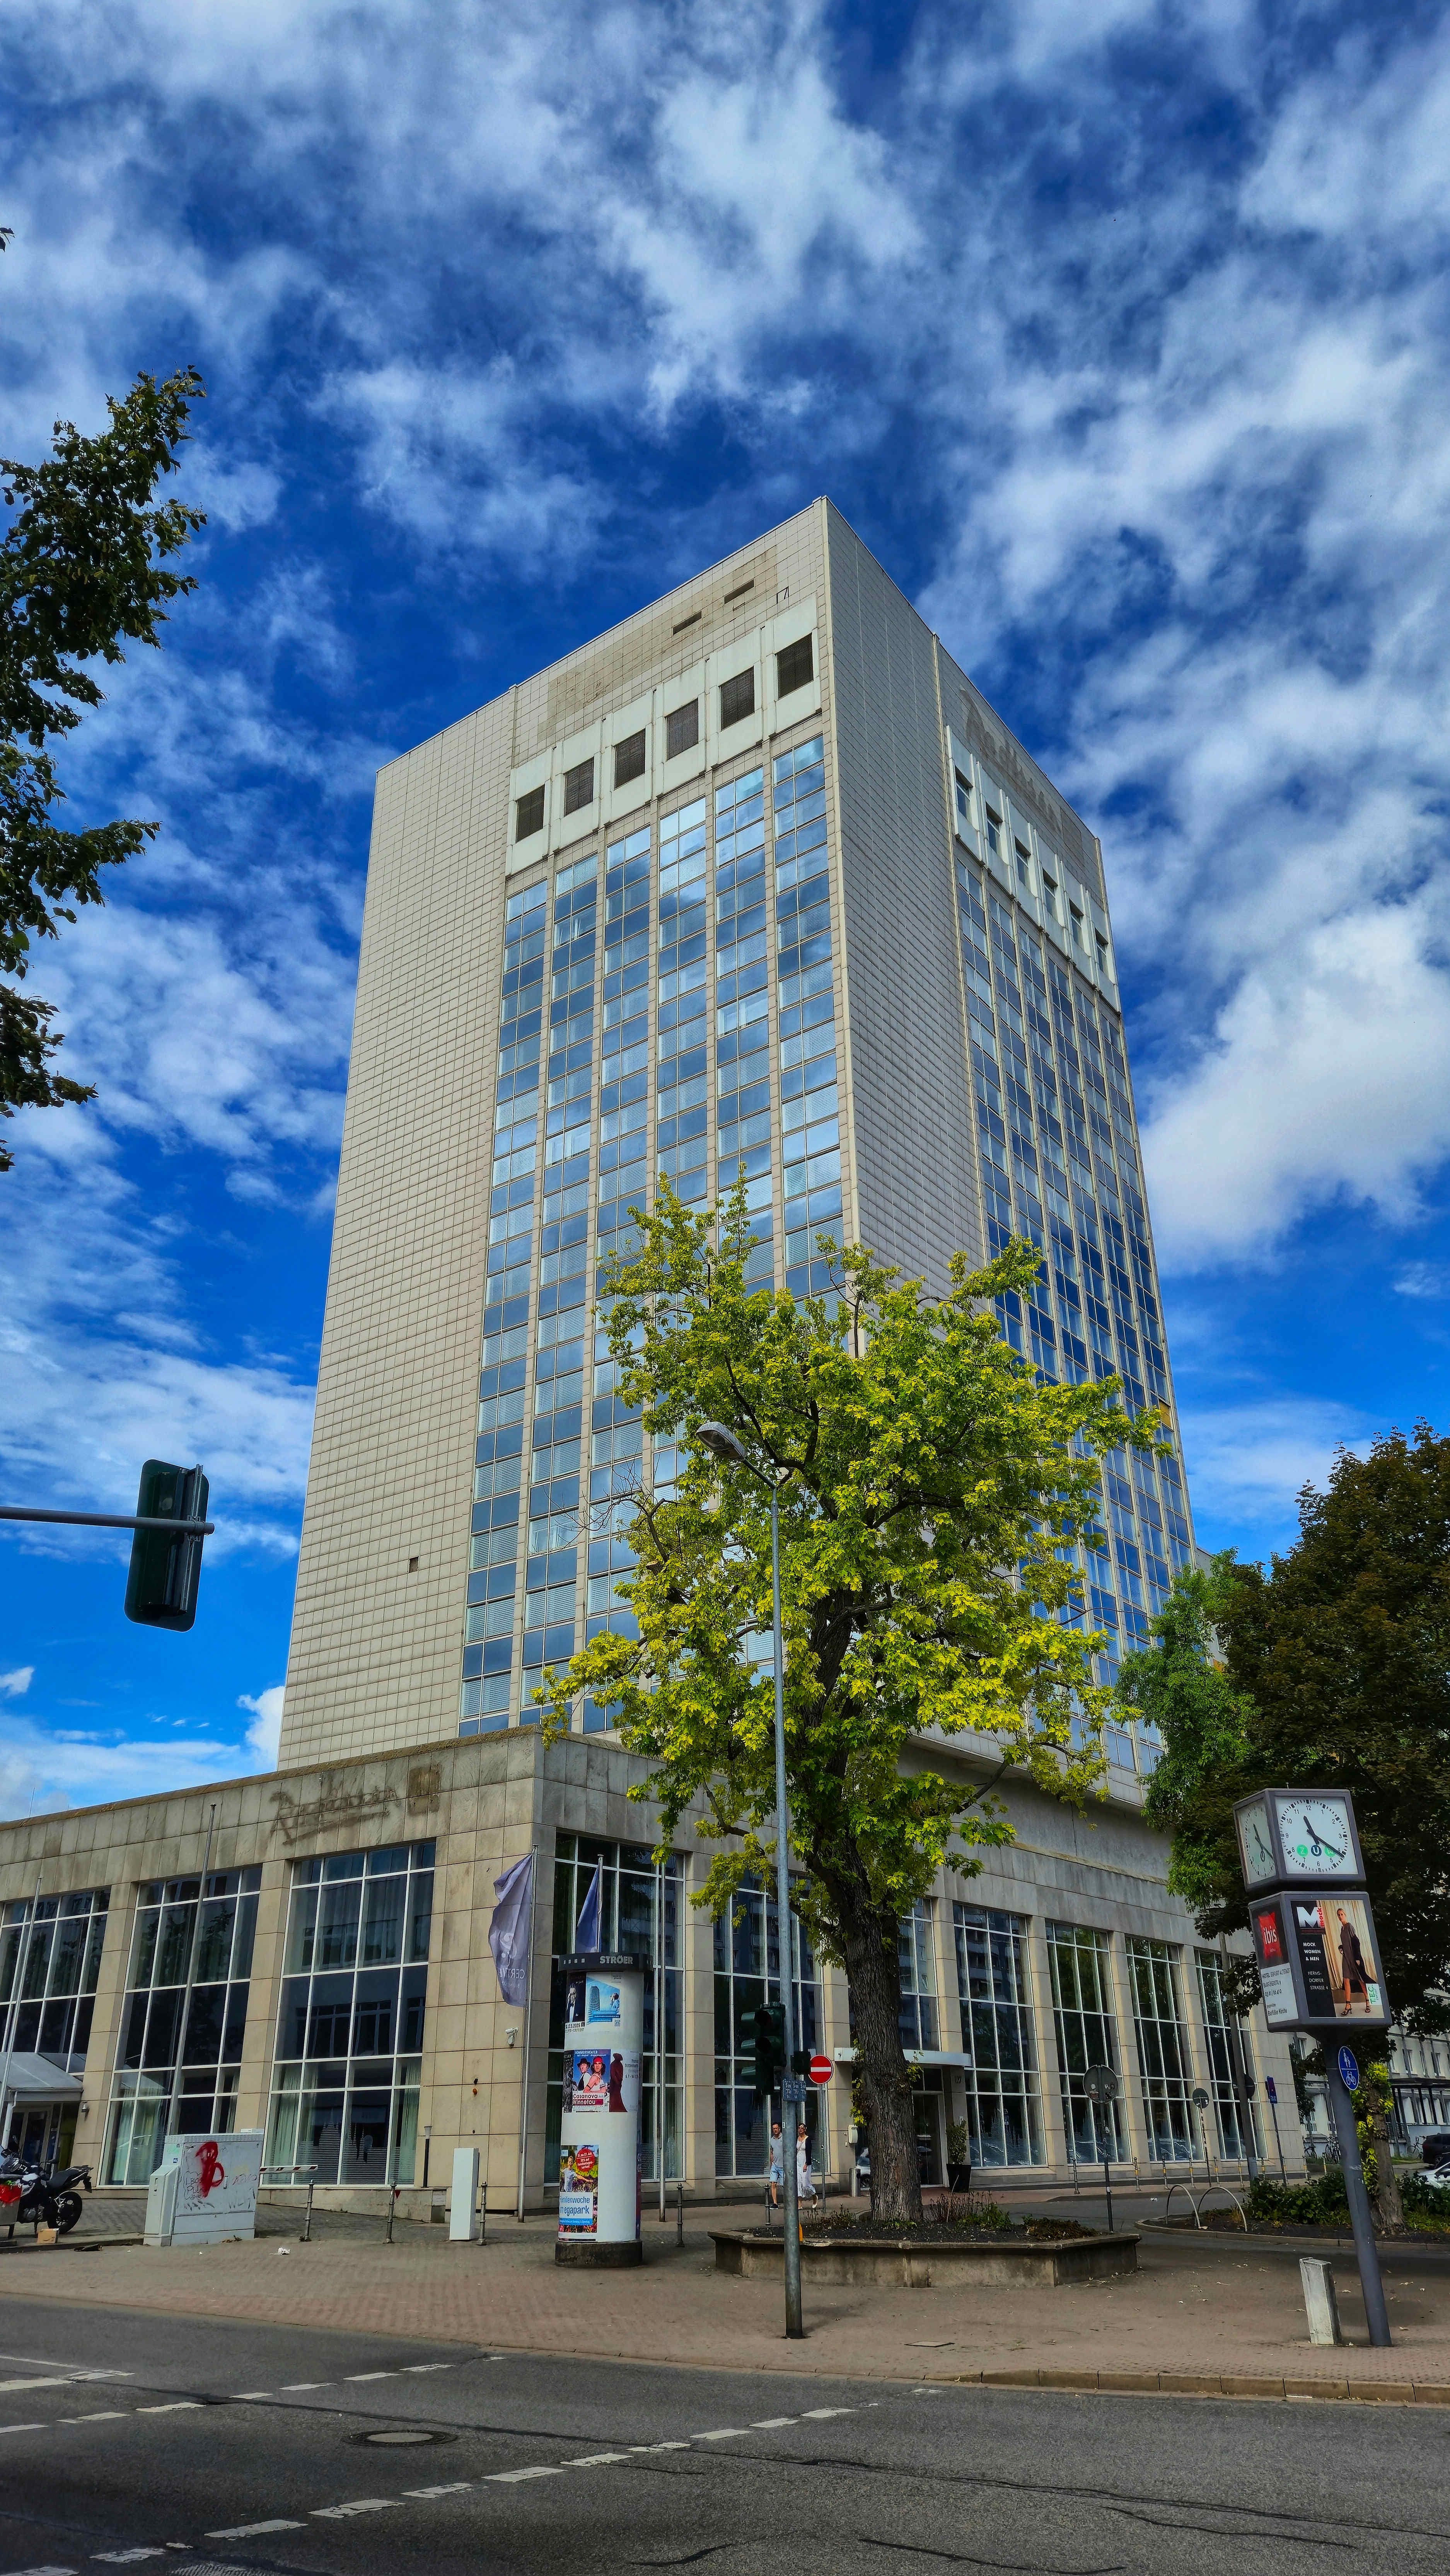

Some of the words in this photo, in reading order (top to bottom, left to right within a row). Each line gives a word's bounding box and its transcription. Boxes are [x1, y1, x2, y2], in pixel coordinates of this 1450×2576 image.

[1317, 1908, 1325, 1927] mock
[1263, 1925, 1277, 1944] ibis
[600, 1955, 633, 1964] STRÖER
[564, 2205, 590, 2217] egapark
